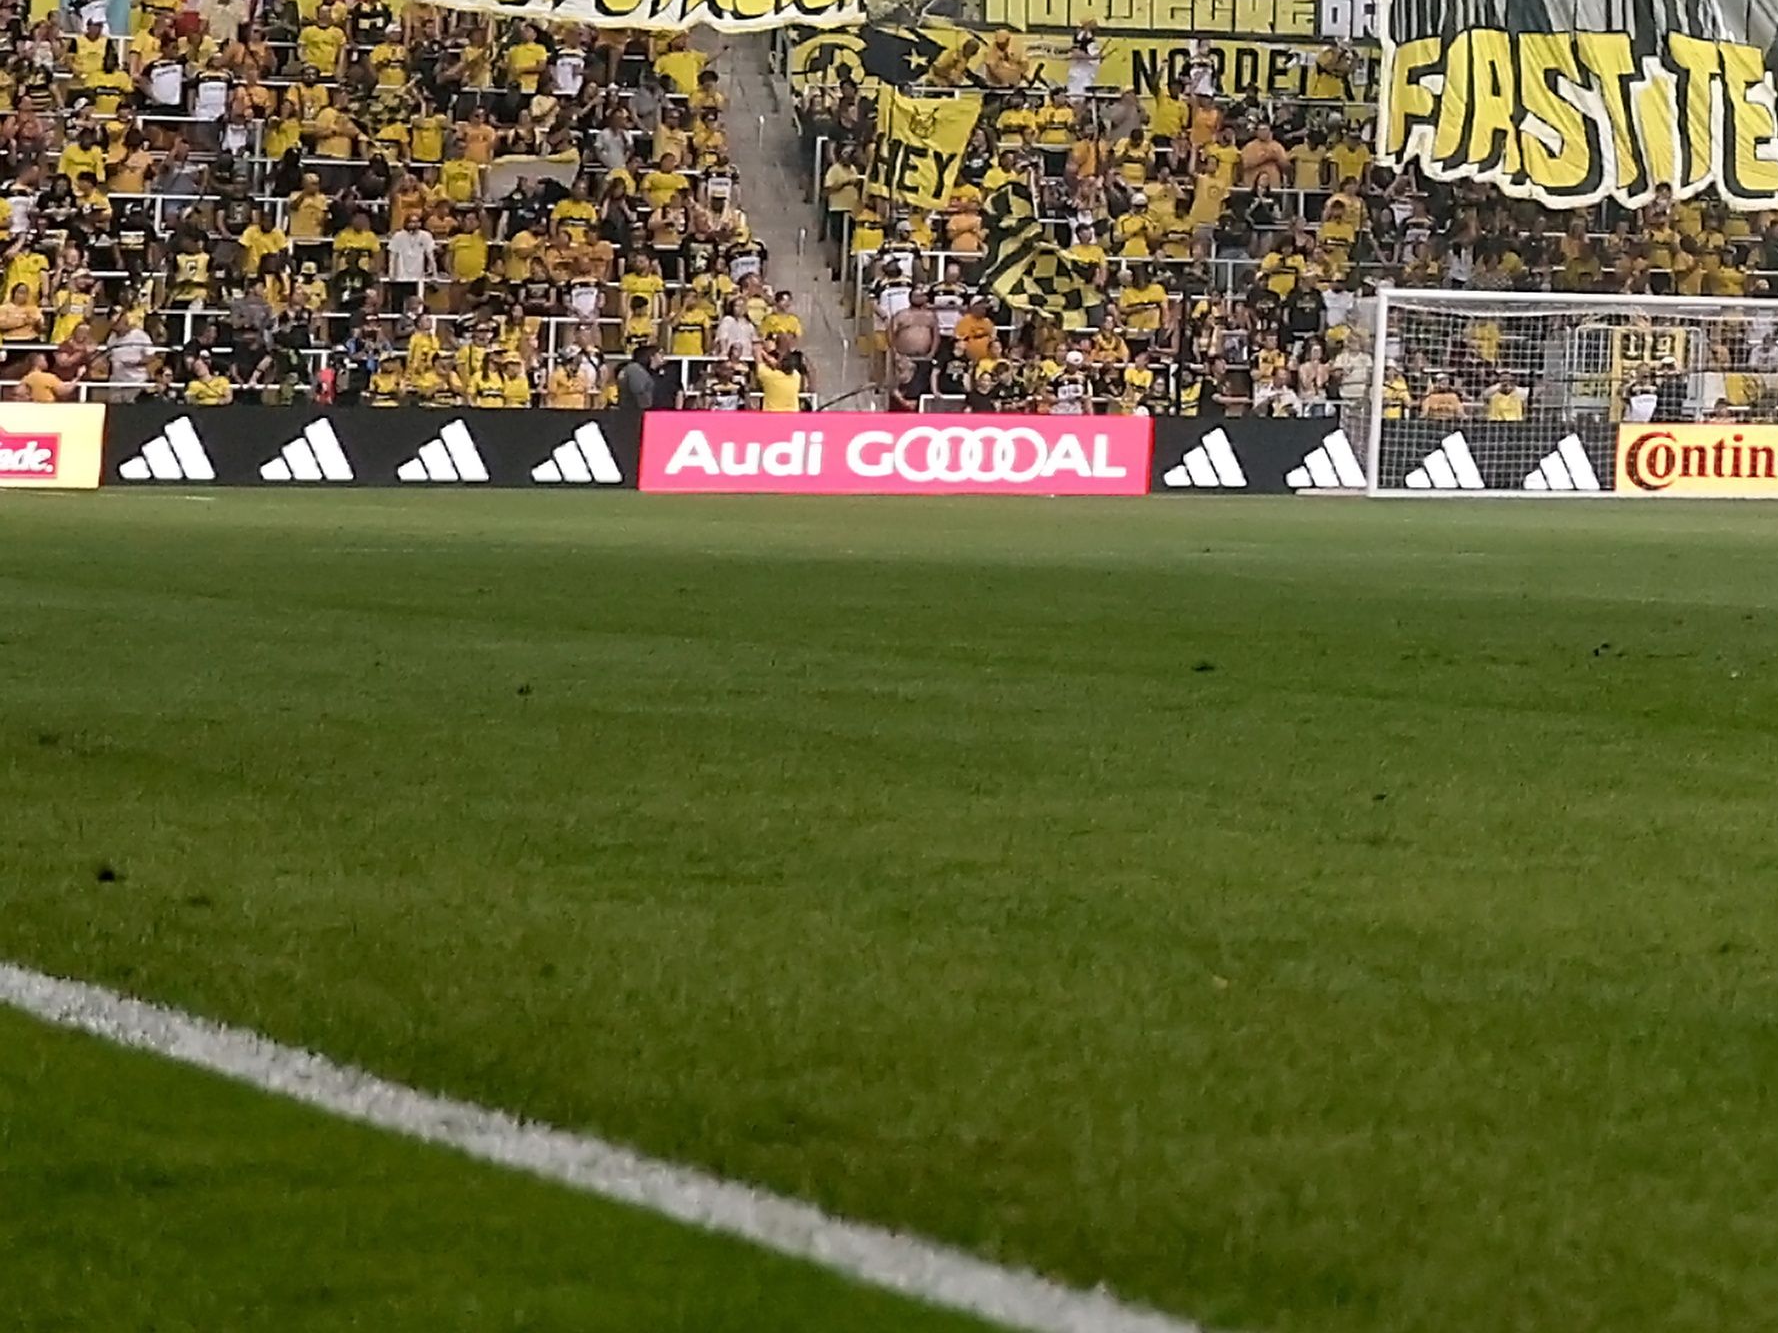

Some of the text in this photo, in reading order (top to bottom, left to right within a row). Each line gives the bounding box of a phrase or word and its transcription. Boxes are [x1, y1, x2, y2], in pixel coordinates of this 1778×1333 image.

[1386, 27, 1650, 197] FIRST
[869, 134, 958, 200] HEY
[665, 428, 823, 476] Audi
